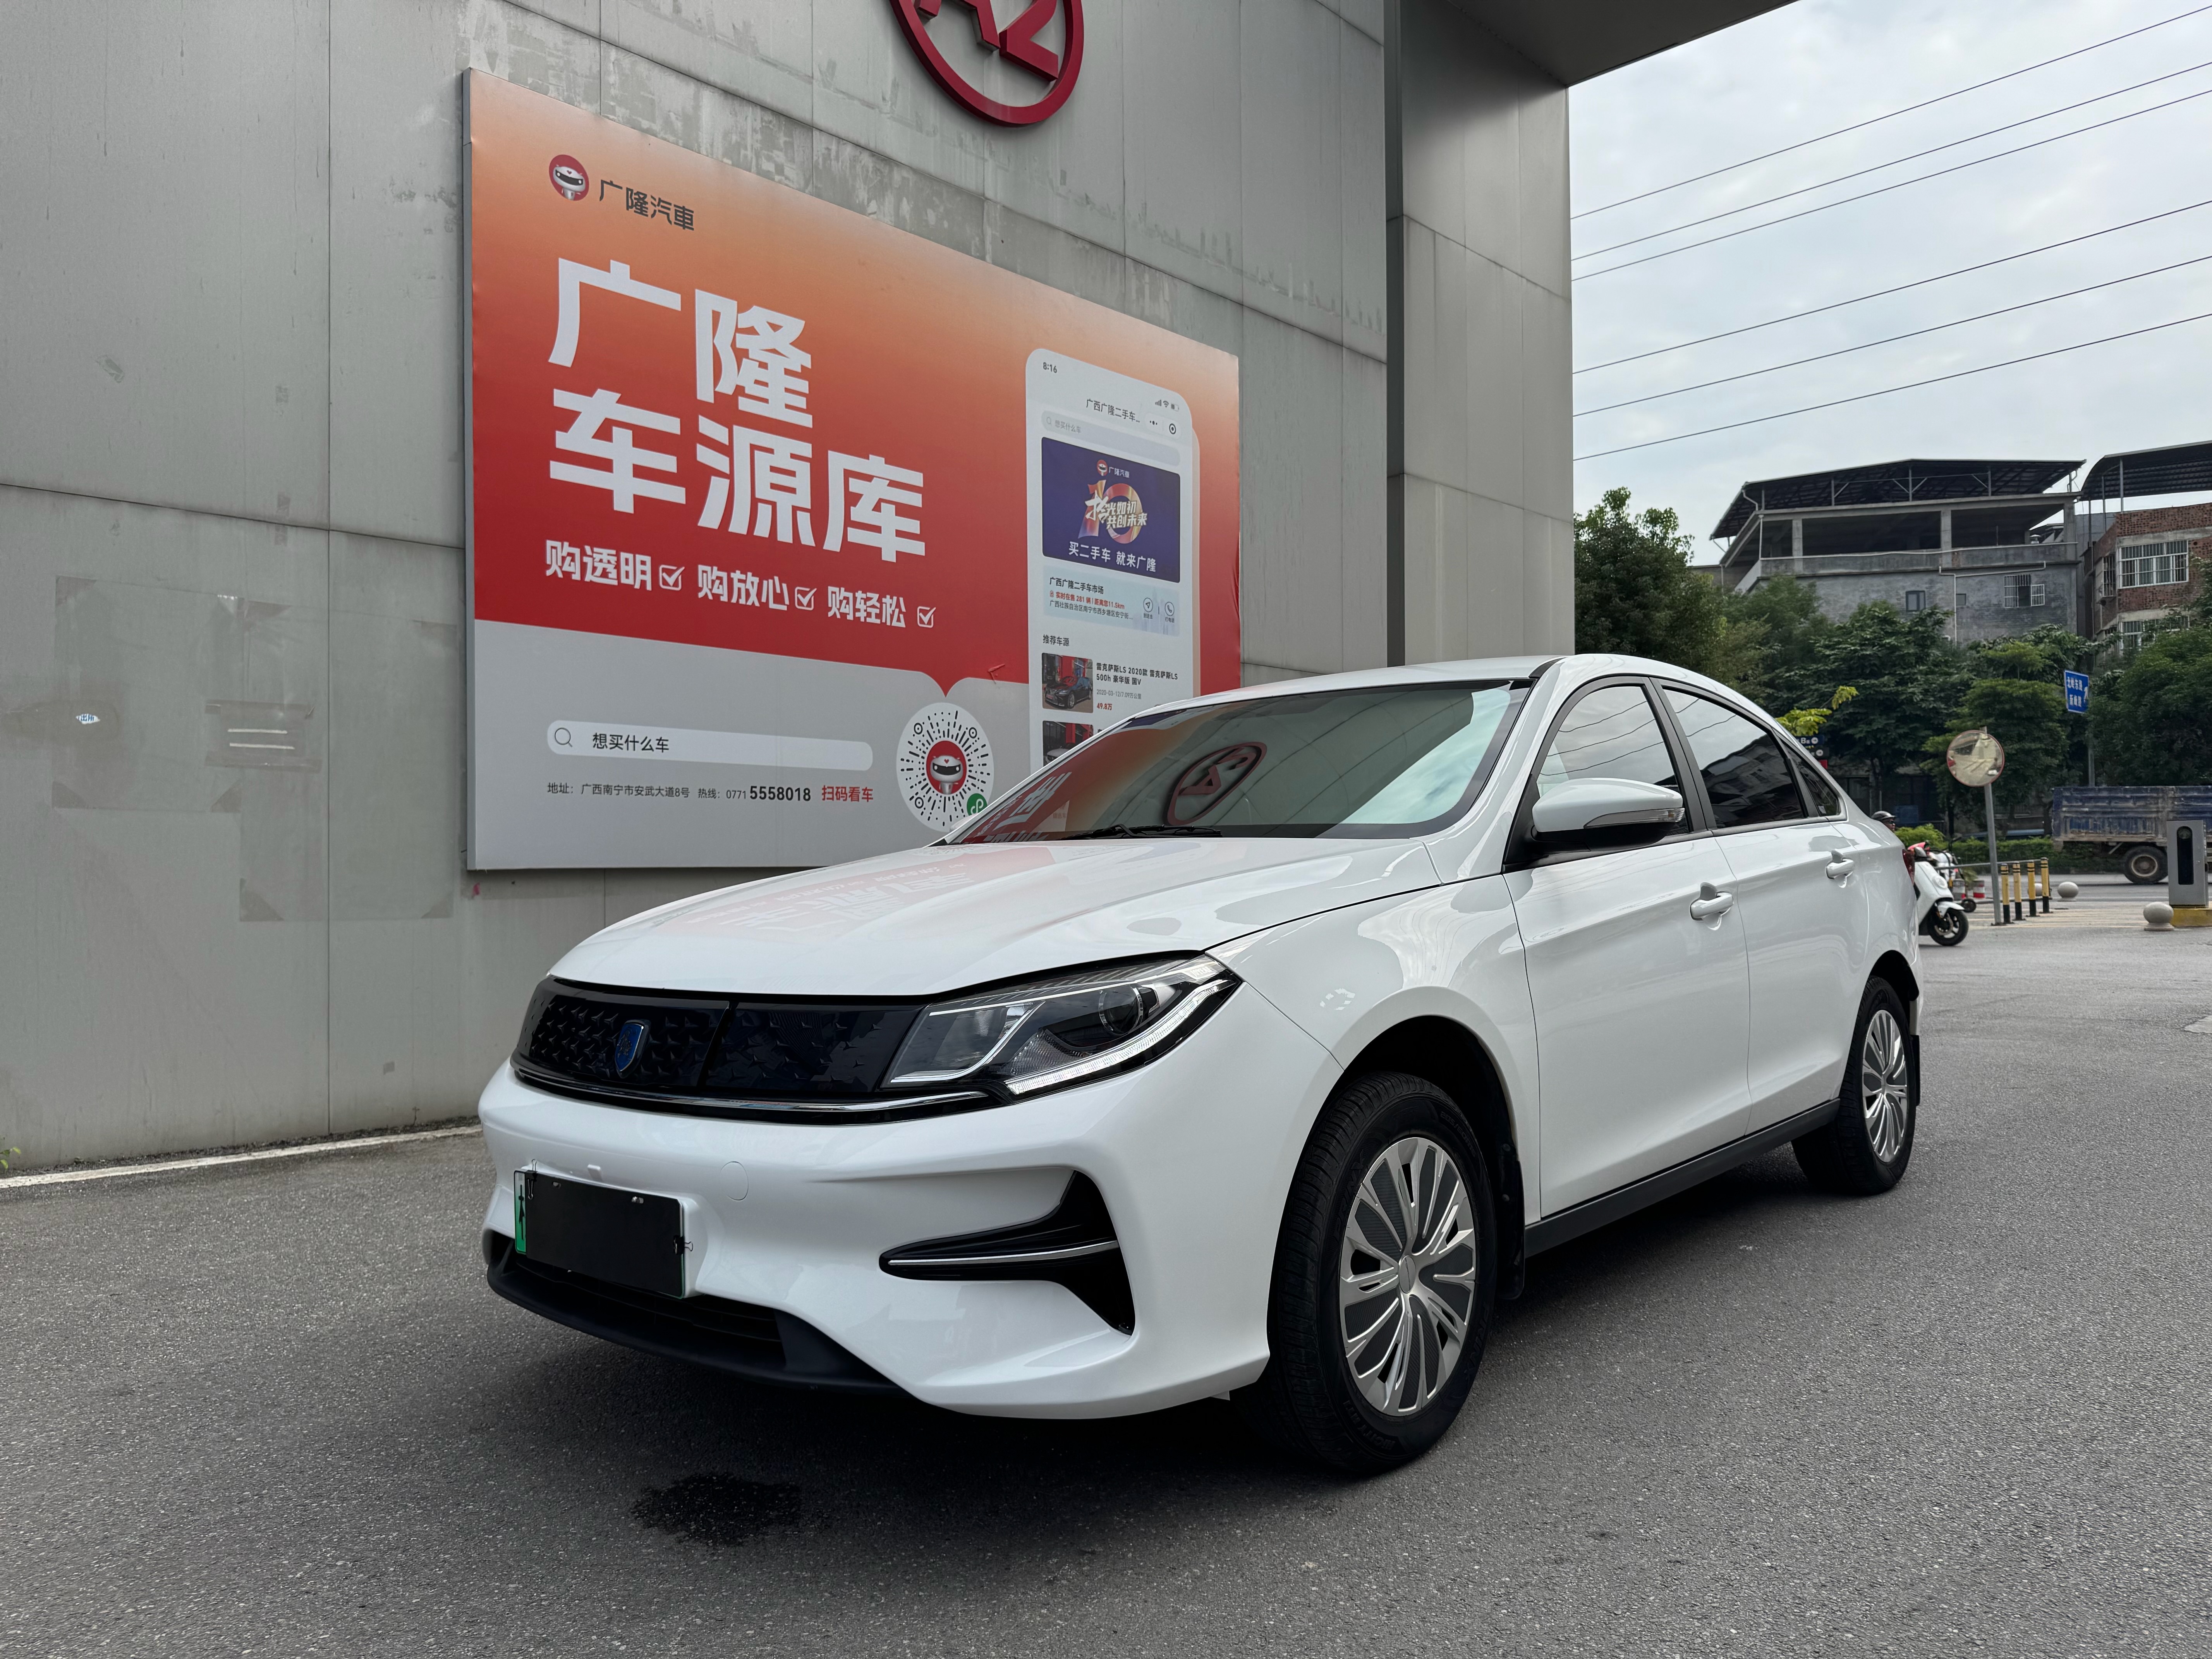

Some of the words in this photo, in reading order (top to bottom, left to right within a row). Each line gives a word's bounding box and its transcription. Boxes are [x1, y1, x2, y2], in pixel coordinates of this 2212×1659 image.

[599, 180, 694, 231] 广隆汽車
[548, 257, 812, 428] 广隆
[1043, 362, 1057, 373] 8:16
[550, 388, 926, 563] 车源库
[1069, 541, 1111, 562] 买二手车
[1116, 551, 1156, 572] 就来广隆
[545, 540, 651, 591] 购透明
[697, 565, 789, 611] 购放心
[827, 587, 906, 628] 购轻松
[1049, 577, 1104, 594] 广西广隆二手车市场
[1043, 634, 1070, 646] 推荐车源
[1096, 663, 1126, 673] 雷克萨斯LS
[1128, 667, 1147, 676] 2020款
[1149, 670, 1178, 680] 雷克萨斯LS
[1113, 675, 1130, 684] 豪华版
[592, 732, 670, 753] 想买什么车
[749, 785, 811, 802] 5558018
[821, 785, 874, 803] 扫码看车
